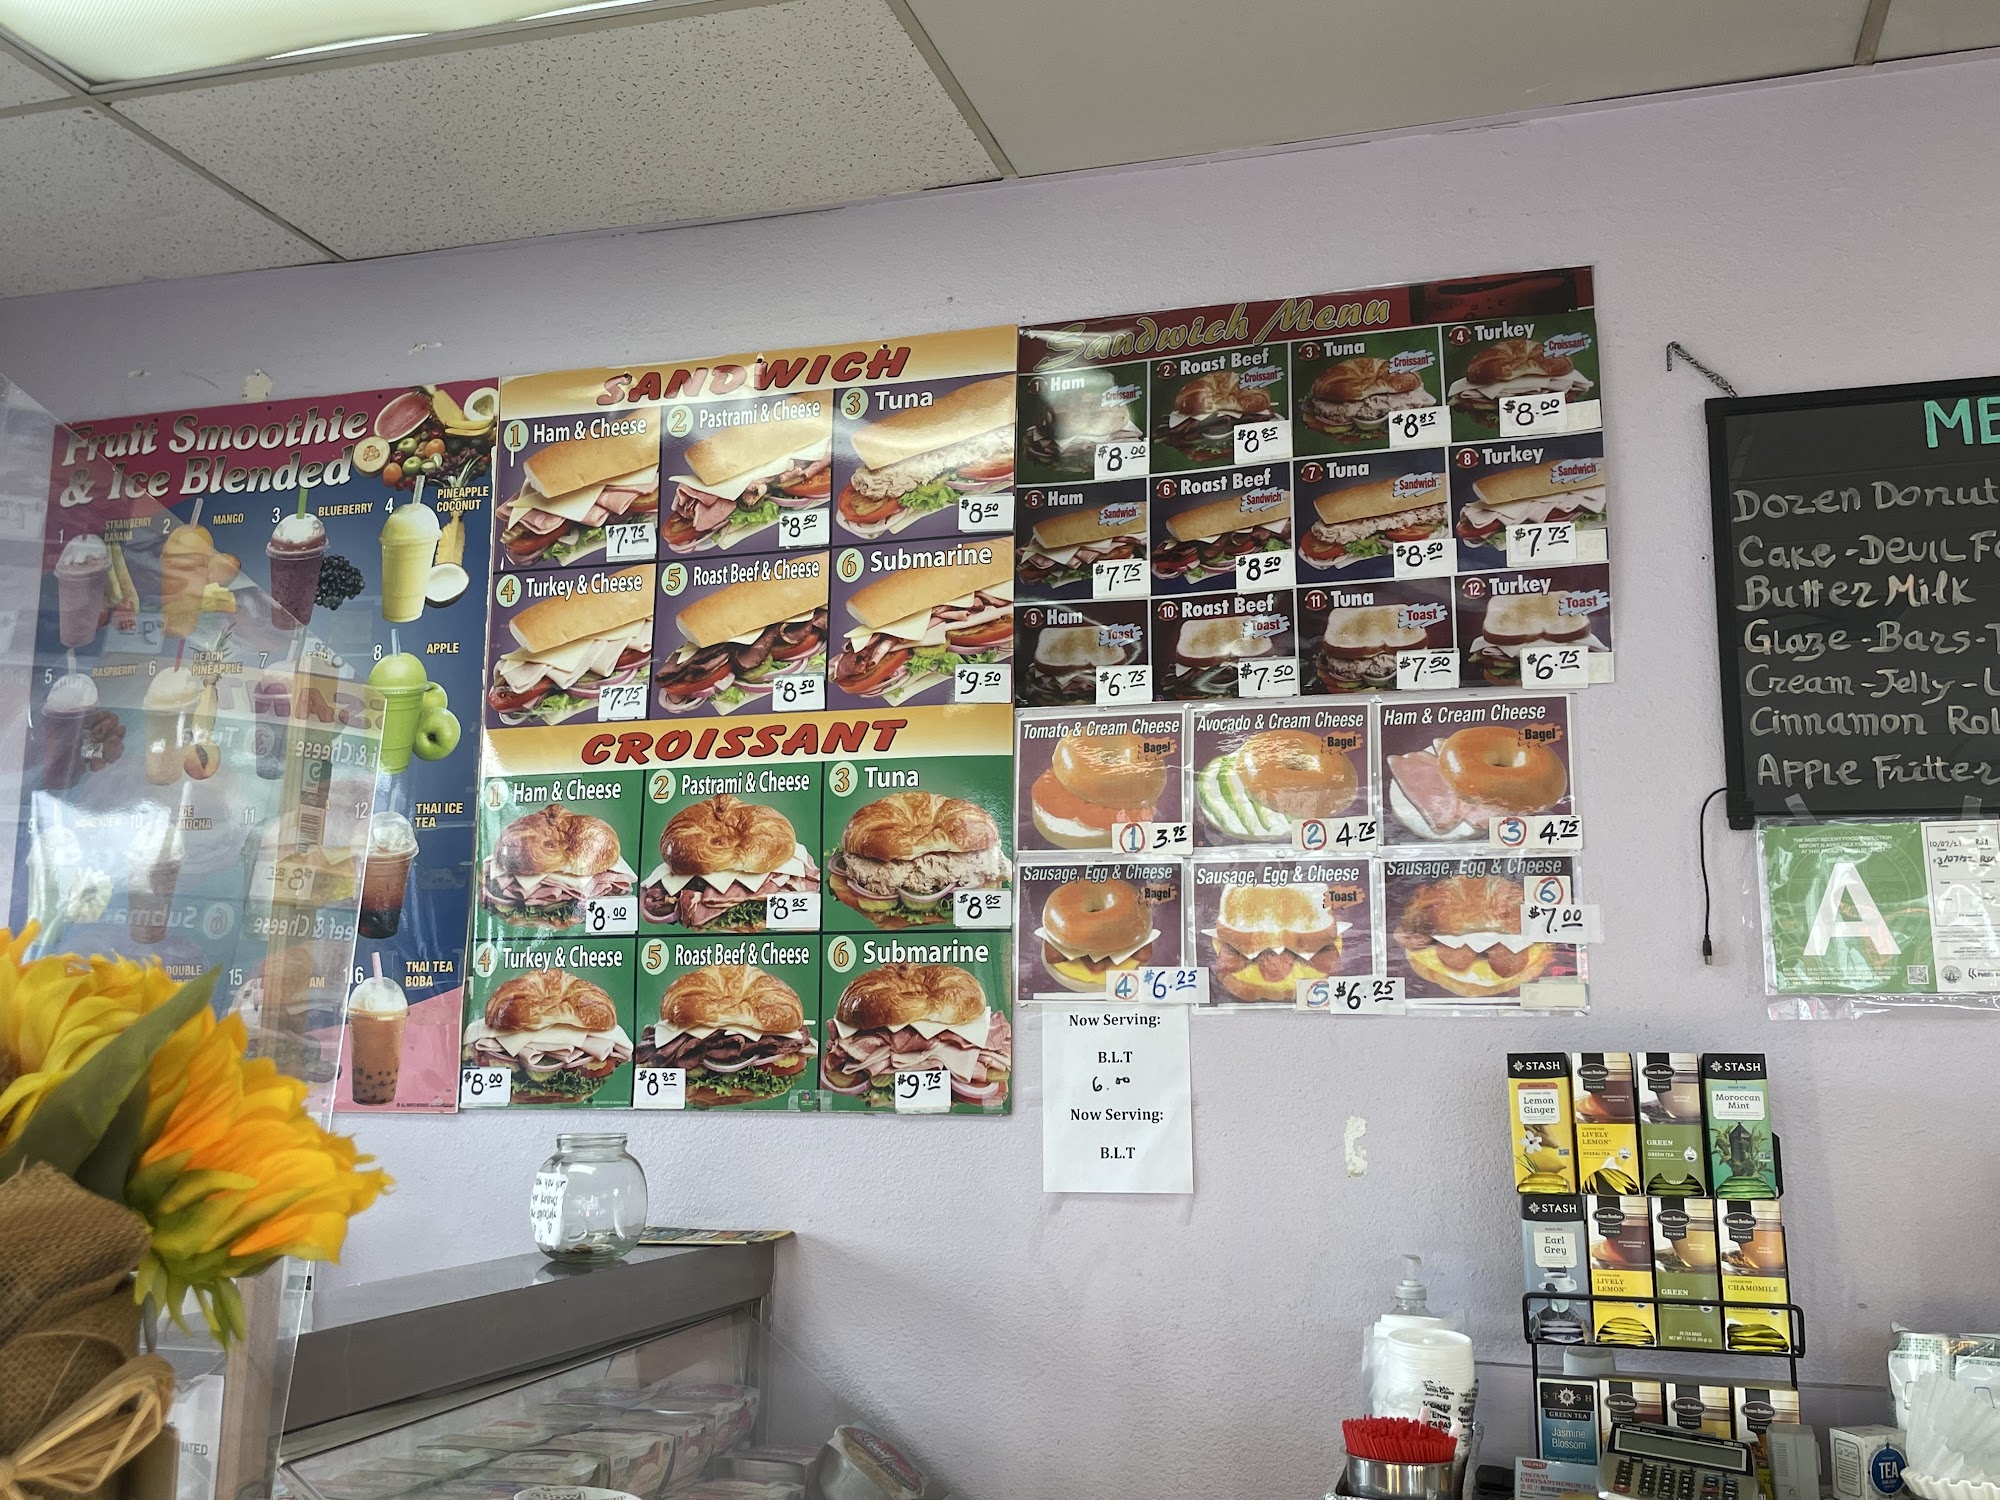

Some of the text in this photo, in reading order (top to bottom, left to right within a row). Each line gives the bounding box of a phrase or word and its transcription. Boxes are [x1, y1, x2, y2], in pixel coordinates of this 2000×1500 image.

[1033, 297, 1390, 372] Sandwich Menu
[1474, 321, 1535, 342] Turkey
[1323, 341, 1366, 357] Tuna
[1180, 348, 1269, 375] Roast Beef
[597, 346, 912, 406] SANDWICH
[1244, 370, 1278, 383] Croissant
[1050, 375, 1085, 392] Ham
[875, 391, 933, 411] Tuna
[1105, 388, 1137, 400] Croissant
[700, 400, 821, 429] Pastrami & Cheese
[62, 406, 368, 466] Fruit Smoothie
[533, 417, 647, 444] Ham & Cheese
[1482, 446, 1544, 465] Turkey
[60, 447, 355, 508] & Ice Blended
[1326, 462, 1370, 479] Tuna
[1180, 468, 1271, 495] Roast Beef
[437, 485, 489, 499] PINEAPPLE
[1047, 491, 1084, 506] Ham
[1246, 492, 1282, 505] Sandwich
[318, 502, 373, 517] BLUEBERRY
[436, 499, 481, 512] COCONUT
[1731, 487, 1862, 523] Dozen
[213, 512, 244, 526] MANGO
[1103, 507, 1137, 520] Sandwich
[105, 517, 152, 530] STRAWBERRY
[104, 530, 134, 542] BANANA
[870, 544, 992, 573] Submarine
[693, 559, 820, 587] Roast Beef & Cheese
[526, 573, 642, 600] Turkey & Cheese
[1489, 575, 1551, 595] Turkey
[1885, 570, 1977, 608] Milk
[1331, 590, 1374, 607] Tuna
[1566, 596, 1598, 608] Toast
[1182, 594, 1274, 618] Roast Beef
[1047, 610, 1083, 625] Ham
[1406, 608, 1438, 621] Toast
[1250, 619, 1281, 631] Toast
[1106, 628, 1134, 640] Toast
[426, 642, 459, 655] APPLE
[193, 650, 223, 663] PEACH
[92, 664, 137, 677] RASPBERRY
[191, 662, 243, 676] PINEAPPLE
[1197, 712, 1364, 732] Avocado & Cream Cheese
[1384, 704, 1546, 726] Ham & Cream Cheese
[1750, 706, 1928, 736] Cinnamon
[1023, 719, 1180, 739] Tomato & Cream Cheese
[1524, 728, 1556, 741] Bagel
[581, 719, 908, 766] CROISSANT
[1143, 742, 1171, 754] Bagel
[1327, 736, 1357, 748] Bagel
[682, 771, 810, 796] Pastrami & Cheese
[864, 766, 919, 788] Tuna
[513, 778, 622, 803] Ham & Cheese
[416, 802, 464, 815] THAI ICE
[415, 816, 436, 829] TEA
[1023, 865, 1173, 883] Sausage, Egg & Cheese
[1197, 866, 1360, 887] Sausage, Egg & Cheese
[1144, 888, 1171, 899] Bagel
[1329, 891, 1357, 902] Toast
[1803, 863, 1902, 956] A
[503, 944, 623, 973] Turkey & Cheese
[675, 942, 809, 966] Roast Beef & Cheese
[863, 939, 989, 964] Submarine
[166, 965, 201, 976] DOUBLE
[405, 960, 454, 974] THAI TEA
[405, 975, 433, 988] BOBA
[1069, 1013, 1161, 1028] Now Serving:
[1098, 1051, 1132, 1063] B.L.T
[1526, 1061, 1560, 1071] STASH
[1724, 1062, 1761, 1072] STASH
[1523, 1096, 1554, 1105] Lemon
[1715, 1093, 1761, 1102] Moroccan
[1523, 1106, 1556, 1115] Ginger
[1728, 1102, 1750, 1110] Mint
[1070, 1108, 1163, 1123] Now Serving:
[1100, 1147, 1135, 1159] B.L.T
[1542, 1203, 1577, 1213] STASH
[1544, 1236, 1565, 1244] Earl
[1544, 1245, 1567, 1256] Grey
[1661, 1288, 1689, 1296] GREEN
[1727, 1284, 1779, 1293] CHAMOMILE
[1574, 1412, 1588, 1420] TEA
[1551, 1427, 1586, 1439] Jasmine
[1551, 1438, 1587, 1449] Blossom
[1879, 1462, 1899, 1479] TEA
